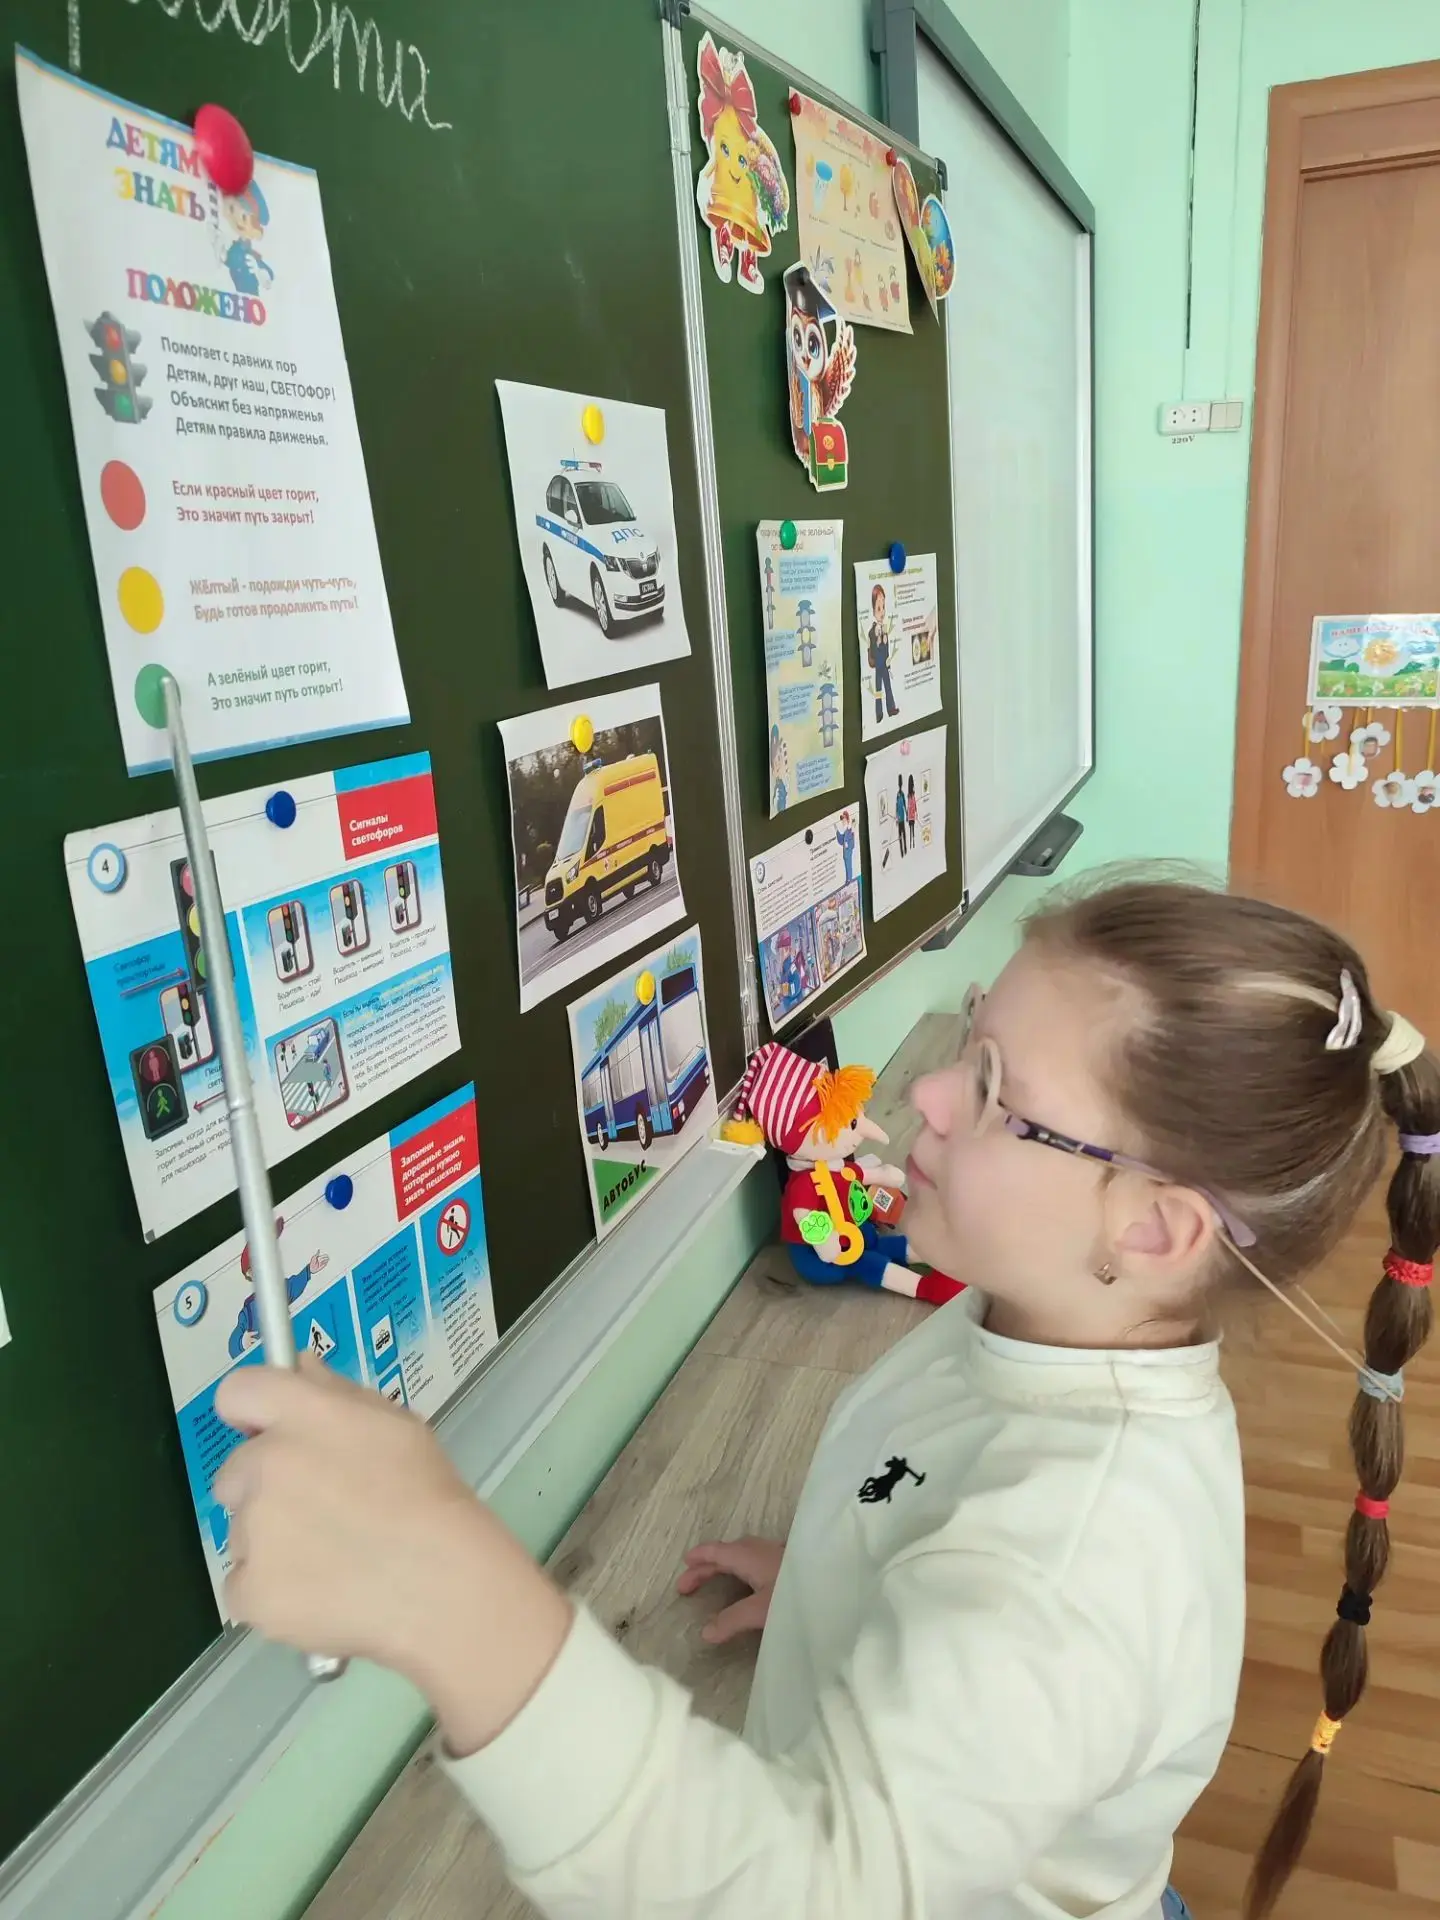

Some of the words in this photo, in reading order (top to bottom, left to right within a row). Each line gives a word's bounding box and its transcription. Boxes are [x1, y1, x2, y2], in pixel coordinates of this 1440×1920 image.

[106, 117, 201, 179] ДЕТЯМ
[114, 166, 205, 222] ЗНАТЬ
[126, 268, 266, 325] ПОЛОЖЕНО
[161, 336, 221, 362] Помогает
[224, 351, 230, 362] с
[232, 352, 273, 371] давних
[276, 359, 298, 376] пор
[167, 364, 211, 387] Детям,
[213, 374, 239, 390] друг
[242, 378, 269, 396] наш,
[271, 380, 336, 402] СВЕТОФОР!
[170, 390, 230, 412] Объяснит
[232, 398, 252, 415] без
[254, 403, 324, 423] напряженья
[176, 417, 217, 436] Детям
[218, 424, 266, 441] правила
[269, 430, 329, 446] движенья.
[172, 480, 202, 497] Если
[205, 484, 256, 501] красный
[258, 488, 283, 502] цвет
[286, 489, 319, 504] горит,
[177, 506, 199, 521] Это
[202, 509, 242, 523] значит
[244, 511, 269, 526] путь
[271, 510, 315, 526] закрыт!
[612, 528, 645, 544] ДПС
[189, 577, 240, 595] Жёлтый
[248, 580, 301, 594] подожди
[302, 577, 357, 593] чуть-чуть,
[194, 604, 224, 623] Будь
[226, 604, 258, 618] готов
[260, 601, 328, 617] продолжить
[330, 596, 359, 612] путь!
[207, 672, 217, 687] А
[218, 664, 268, 686] зелёный
[271, 665, 296, 680] цвет
[298, 661, 331, 676] горит,
[211, 697, 233, 711] Это
[235, 691, 272, 708] значит
[274, 687, 299, 703] путь
[301, 678, 344, 697] открыт!
[349, 814, 389, 832] Сигналы
[351, 824, 404, 847] светофоров
[102, 859, 110, 874] 4
[401, 1141, 434, 1168] Запомни
[402, 1149, 442, 1183] дорожные
[442, 1134, 466, 1154] знаки,
[403, 1166, 436, 1194] которые
[436, 1150, 460, 1171] нужно
[404, 1187, 426, 1207] знать
[426, 1160, 463, 1191] пешеходу
[603, 1159, 648, 1213] АВТОБУС
[185, 1296, 193, 1310] 5
